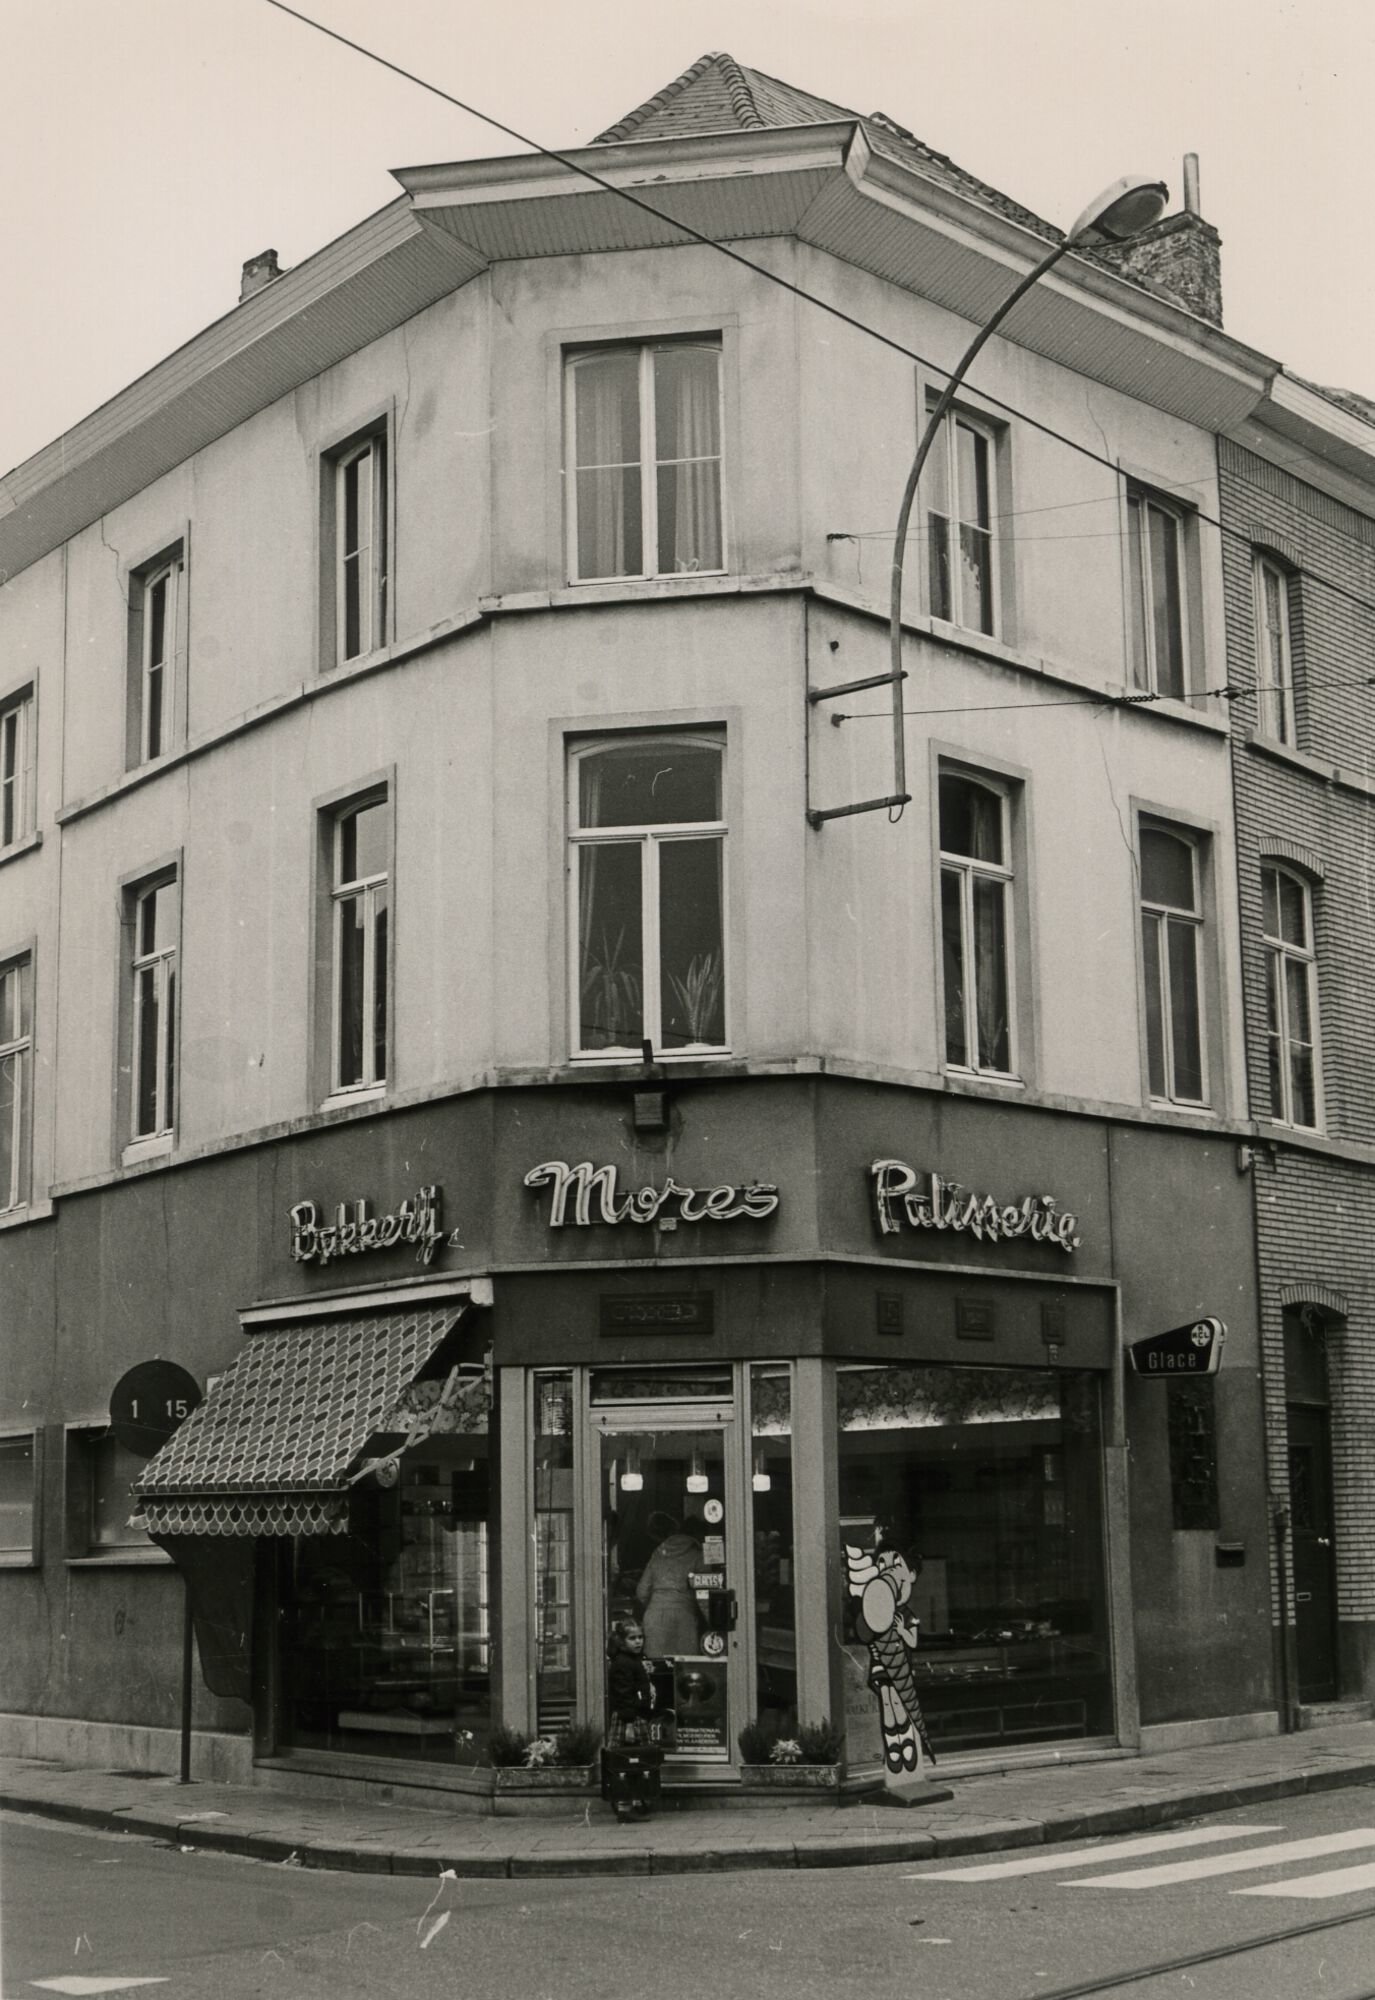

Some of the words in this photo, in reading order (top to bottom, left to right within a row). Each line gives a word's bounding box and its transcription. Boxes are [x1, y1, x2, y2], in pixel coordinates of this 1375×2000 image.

[287, 1184, 444, 1265] Bakkerij
[523, 1160, 780, 1227] Mores
[870, 1158, 1083, 1253] Patisserie
[1148, 1351, 1197, 1369] Glace
[131, 1399, 139, 1419] 1
[165, 1399, 188, 1419] 15
